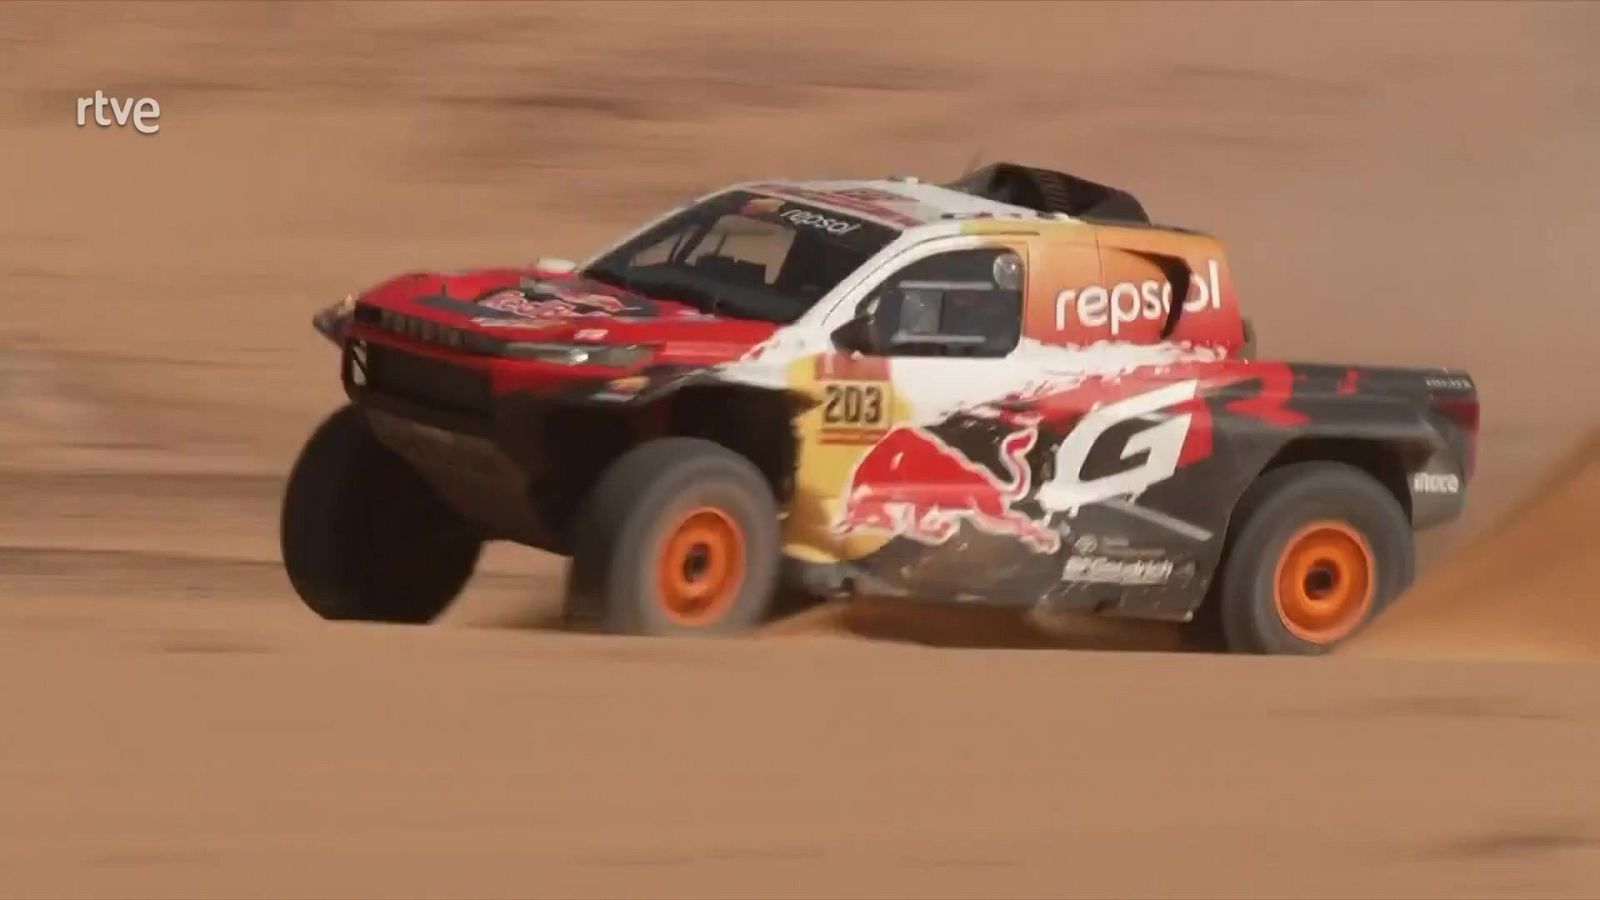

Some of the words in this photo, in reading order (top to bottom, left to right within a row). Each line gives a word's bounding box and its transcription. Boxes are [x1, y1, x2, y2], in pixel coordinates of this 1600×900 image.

[779, 208, 861, 235] repsol
[1055, 259, 1221, 335] repsol
[824, 385, 882, 423] 203
